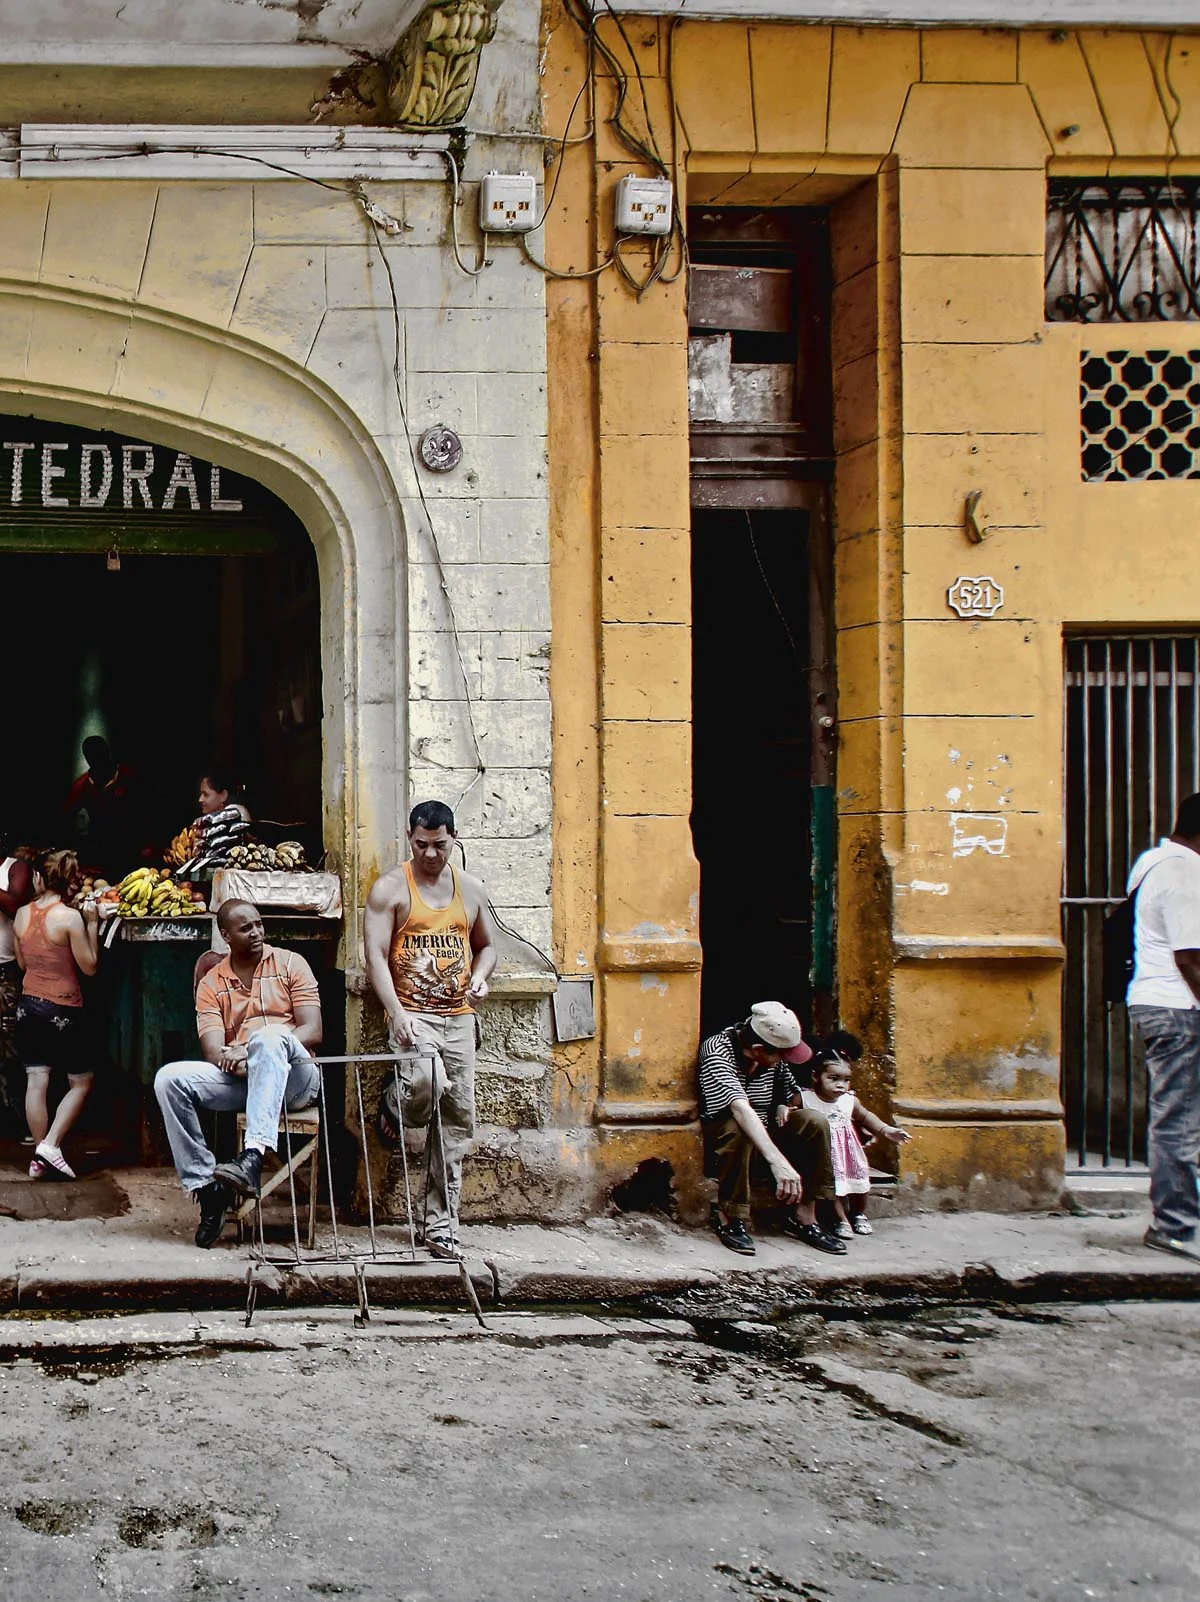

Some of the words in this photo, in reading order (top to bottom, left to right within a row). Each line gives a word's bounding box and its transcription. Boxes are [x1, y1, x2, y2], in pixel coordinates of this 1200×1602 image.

[960, 585, 994, 609] 521
[402, 934, 464, 949] AMERICAN
[436, 949, 460, 959] Eagle
